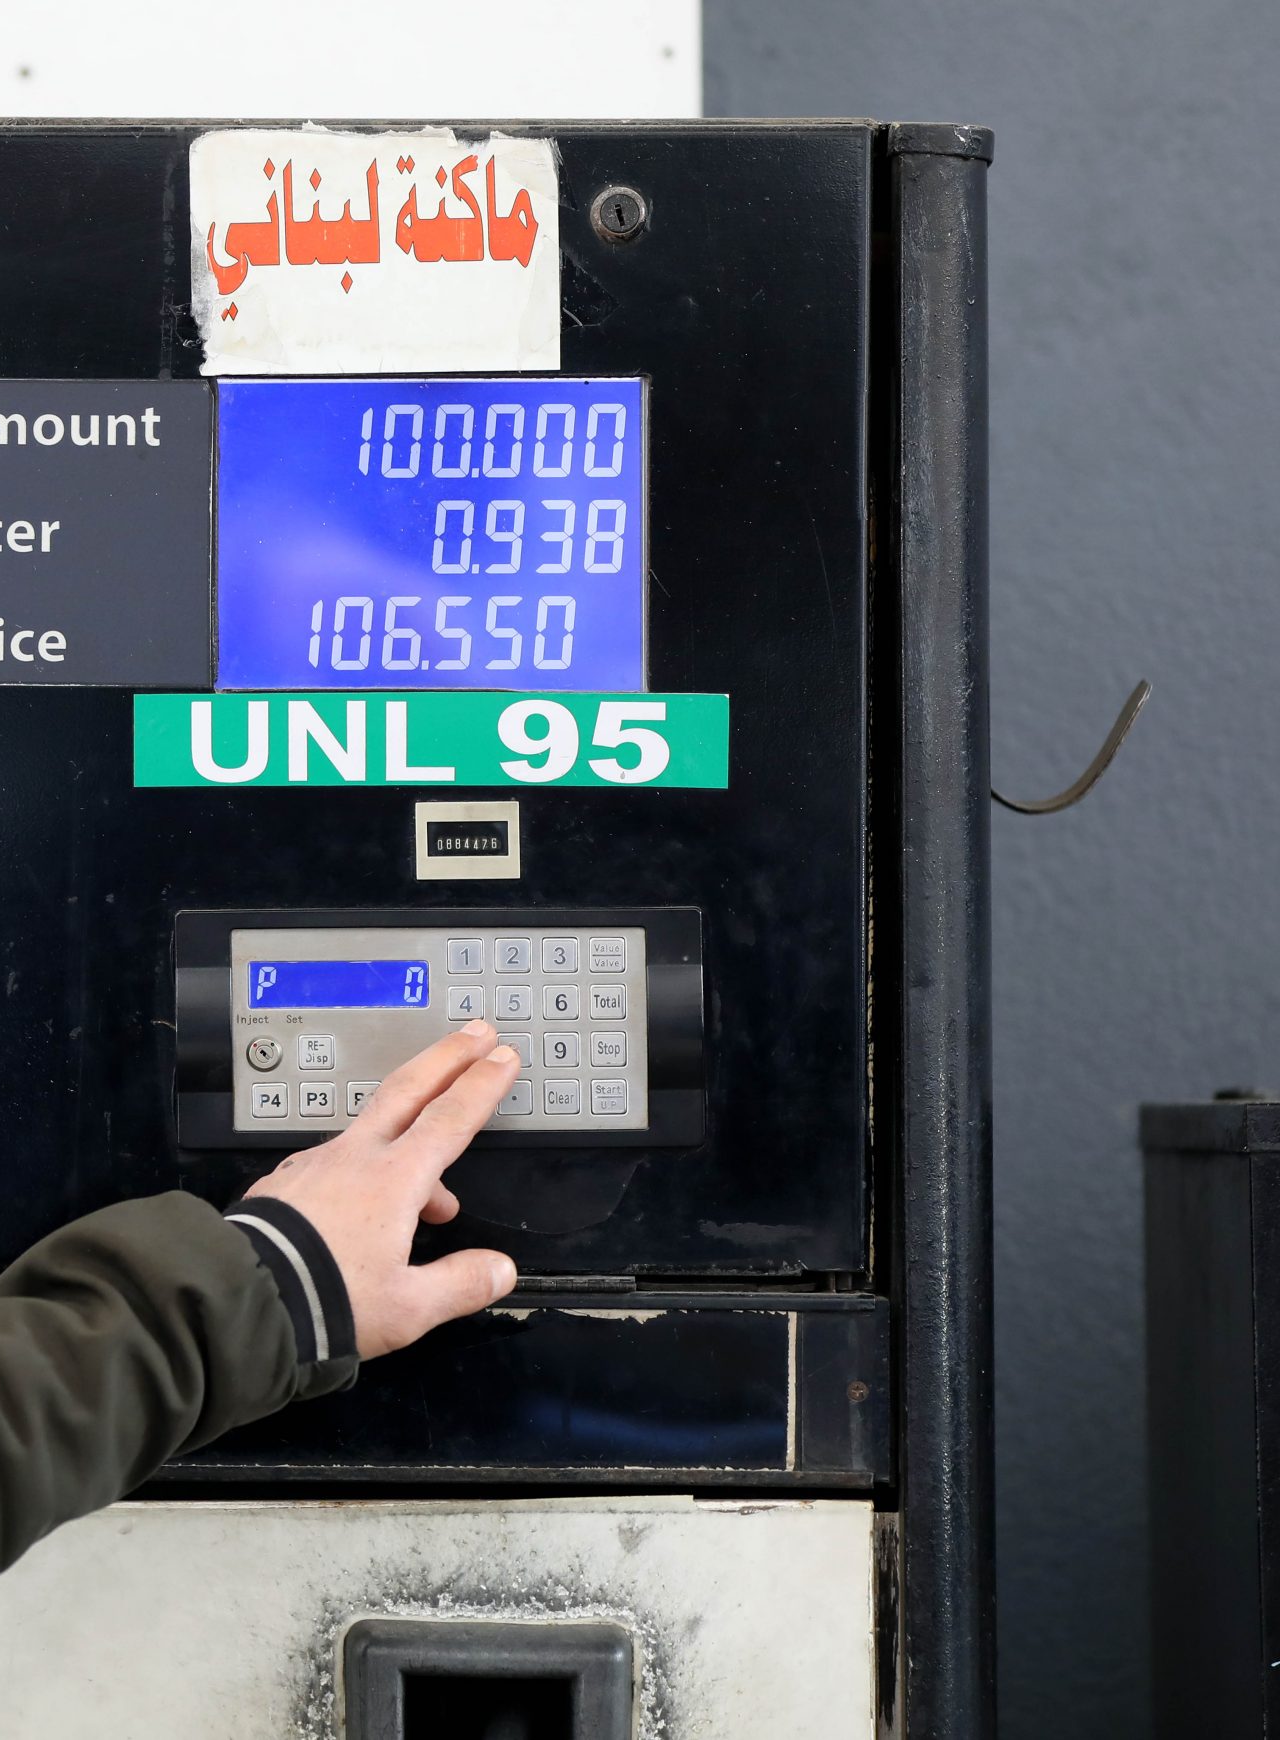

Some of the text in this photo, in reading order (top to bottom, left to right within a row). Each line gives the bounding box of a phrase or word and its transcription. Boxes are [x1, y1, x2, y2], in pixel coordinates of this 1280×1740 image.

[206, 153, 539, 321] ماكنة لبناني
[357, 403, 627, 480] 100.000
[431, 499, 627, 576] 0.938
[308, 595, 577, 672] 106.550
[190, 700, 672, 786] UNL 95
[437, 837, 498, 851] 0884476
[460, 947, 469, 966] 1
[506, 946, 519, 965] 2
[553, 946, 567, 965] 3
[593, 943, 620, 952] Value
[593, 959, 620, 968] Valve
[256, 966, 424, 1003] P 0
[459, 994, 473, 1013] 4
[507, 993, 521, 1012] 5
[554, 993, 568, 1012] 6
[593, 994, 621, 1009] Total
[236, 1014, 304, 1026] Inject Set
[554, 1041, 567, 1060] 9
[597, 1040, 621, 1058] Stop
[354, 1091, 375, 1107] P
[547, 1090, 575, 1105] Clear
[595, 1084, 622, 1095] Start
[259, 1093, 282, 1109] P4
[306, 1092, 329, 1107] P3
